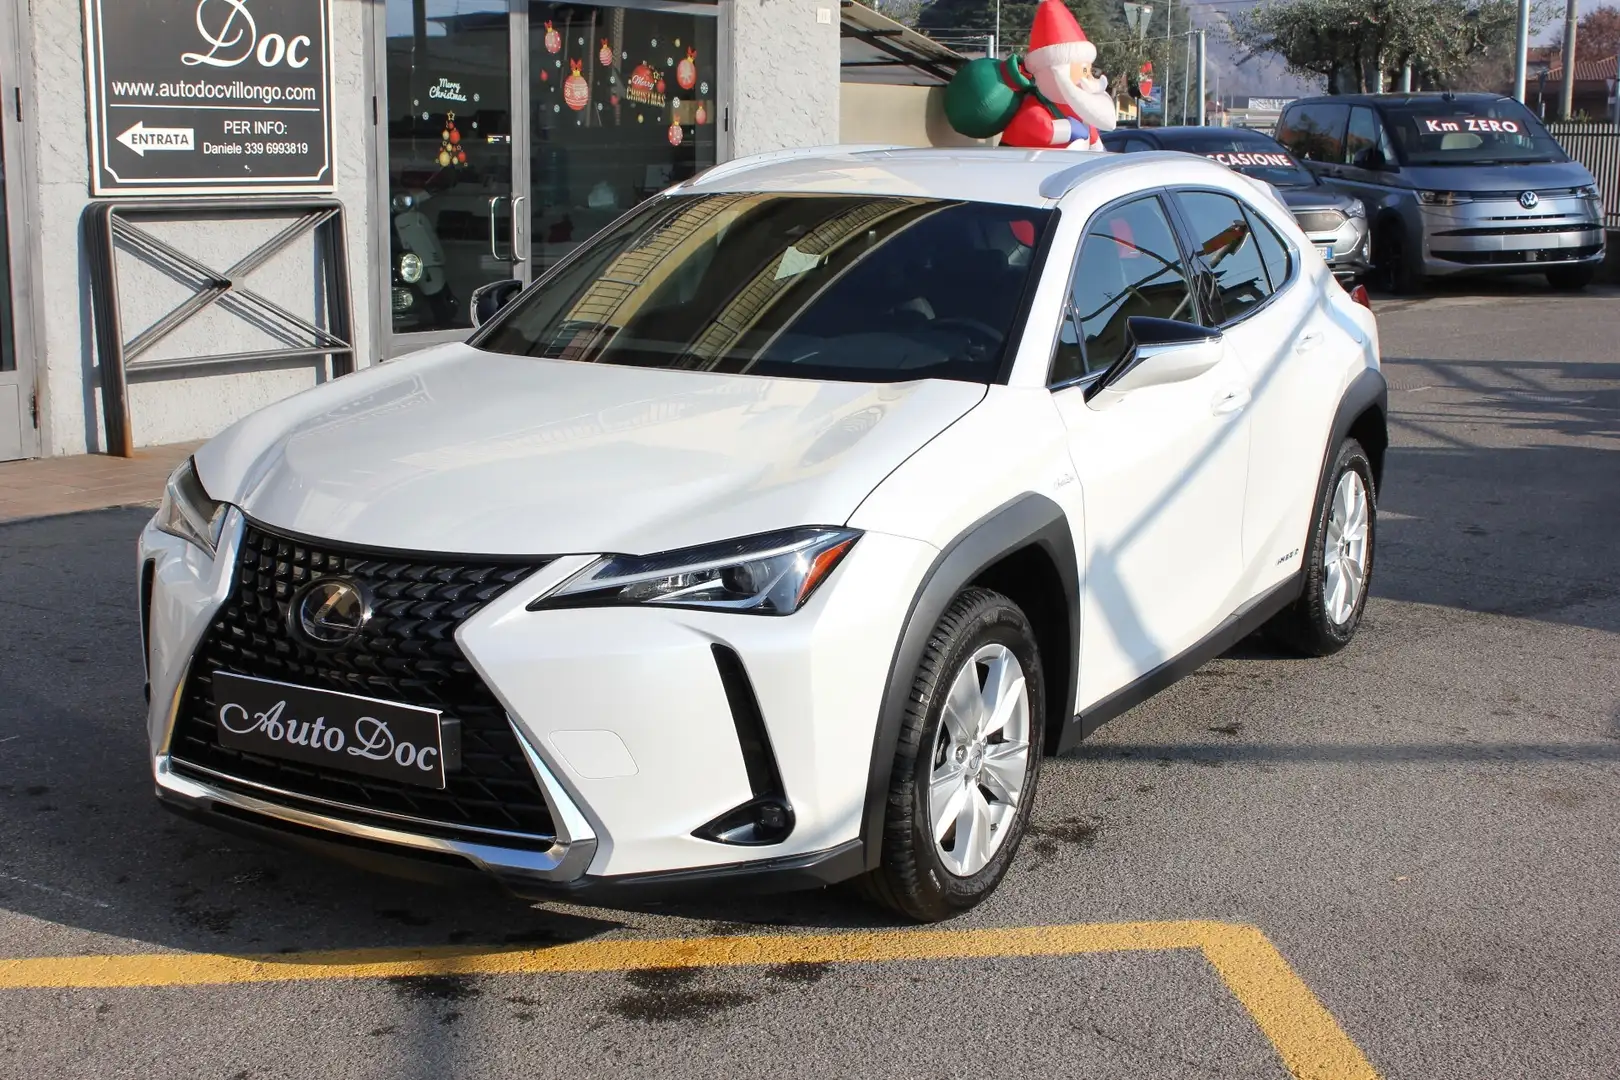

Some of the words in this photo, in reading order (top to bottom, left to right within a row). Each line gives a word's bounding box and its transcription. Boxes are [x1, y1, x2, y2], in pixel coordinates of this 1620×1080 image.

[180, 0, 311, 68] Doc
[439, 77, 461, 94] Merry
[631, 74, 655, 91] Merry
[111, 79, 317, 104] www.autodocvillongo.com
[429, 85, 467, 102] Christmas
[626, 86, 666, 108] CHRISTMAS
[223, 120, 251, 135] PER
[254, 121, 288, 135] INFO:
[1425, 119, 1460, 132] Km
[1464, 119, 1518, 133] ZERO
[131, 133, 190, 146] ENTRATA
[203, 141, 243, 155] Daniele
[245, 142, 264, 155] 339
[266, 142, 309, 155] 6993819
[219, 700, 345, 752] Auto
[346, 716, 438, 771] Doc
